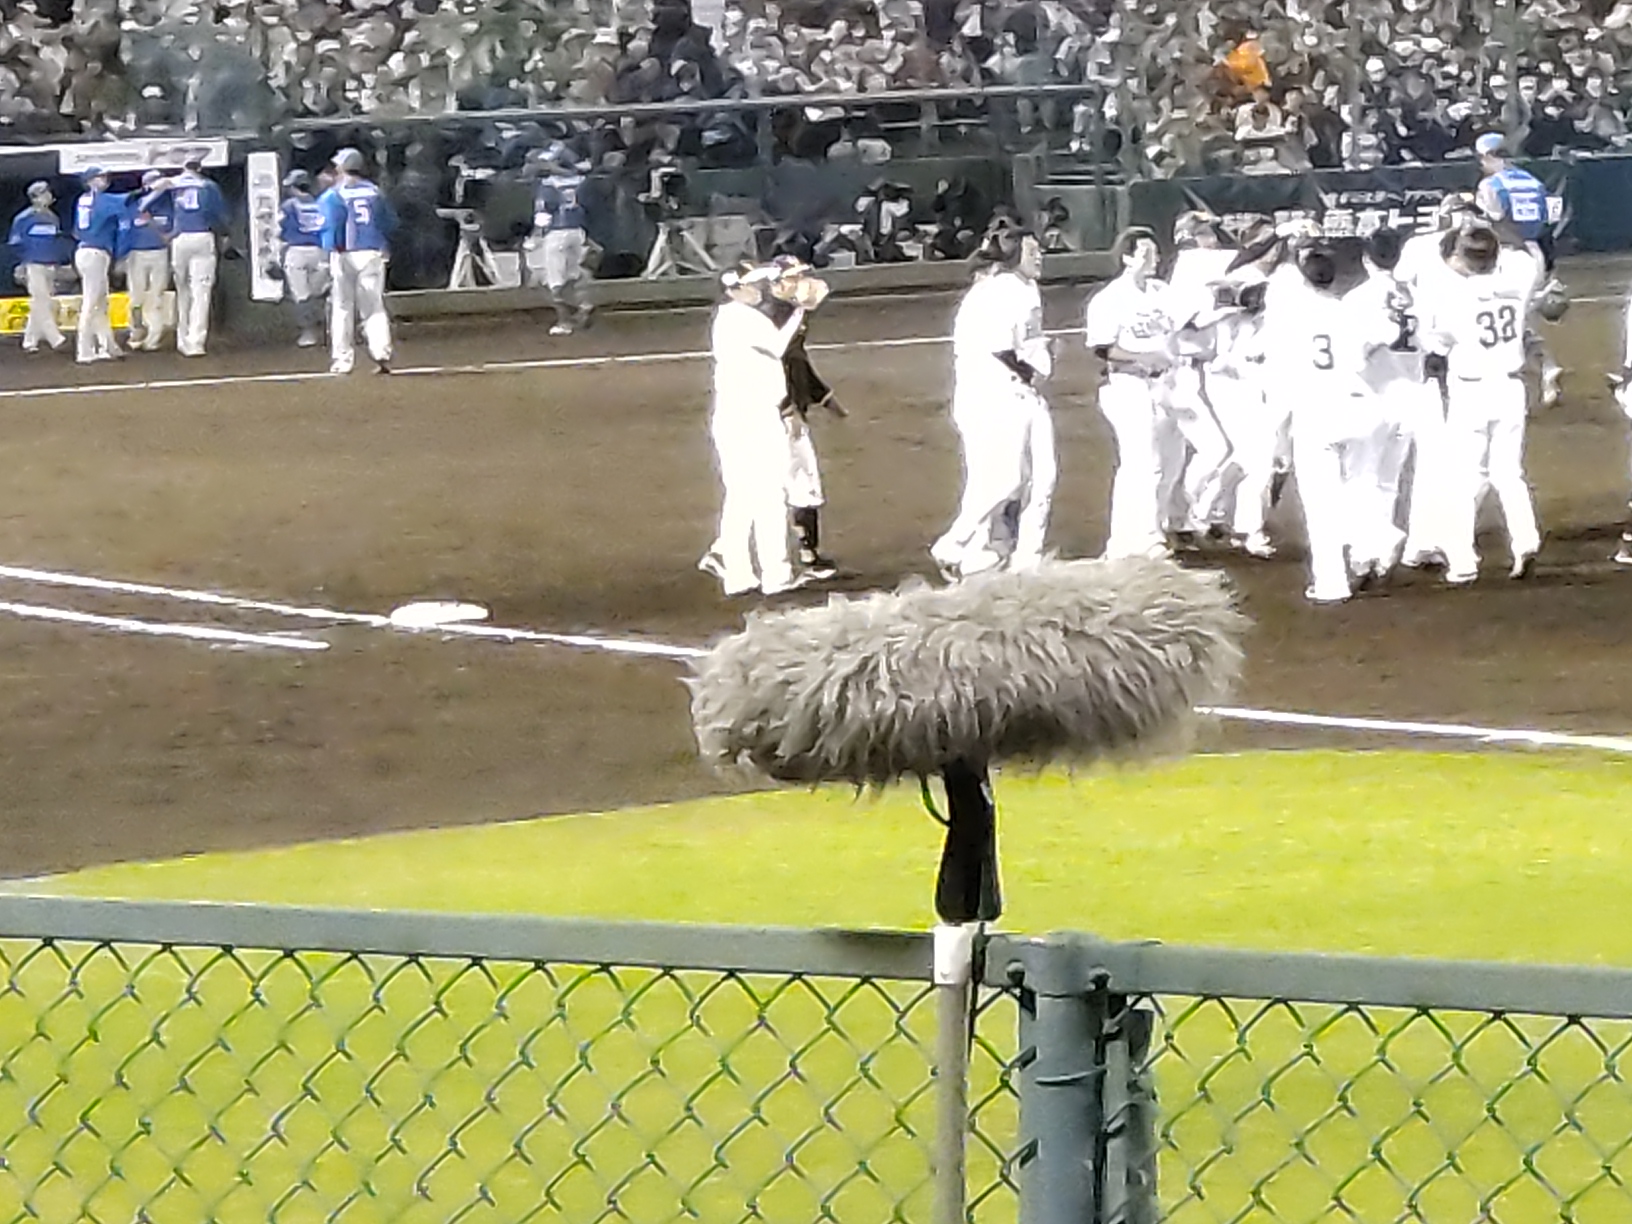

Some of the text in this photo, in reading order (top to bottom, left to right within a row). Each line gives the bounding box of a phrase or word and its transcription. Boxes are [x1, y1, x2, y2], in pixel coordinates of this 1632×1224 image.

[353, 198, 370, 225] 5
[1476, 305, 1517, 349] 32
[1312, 334, 1335, 370] 3
